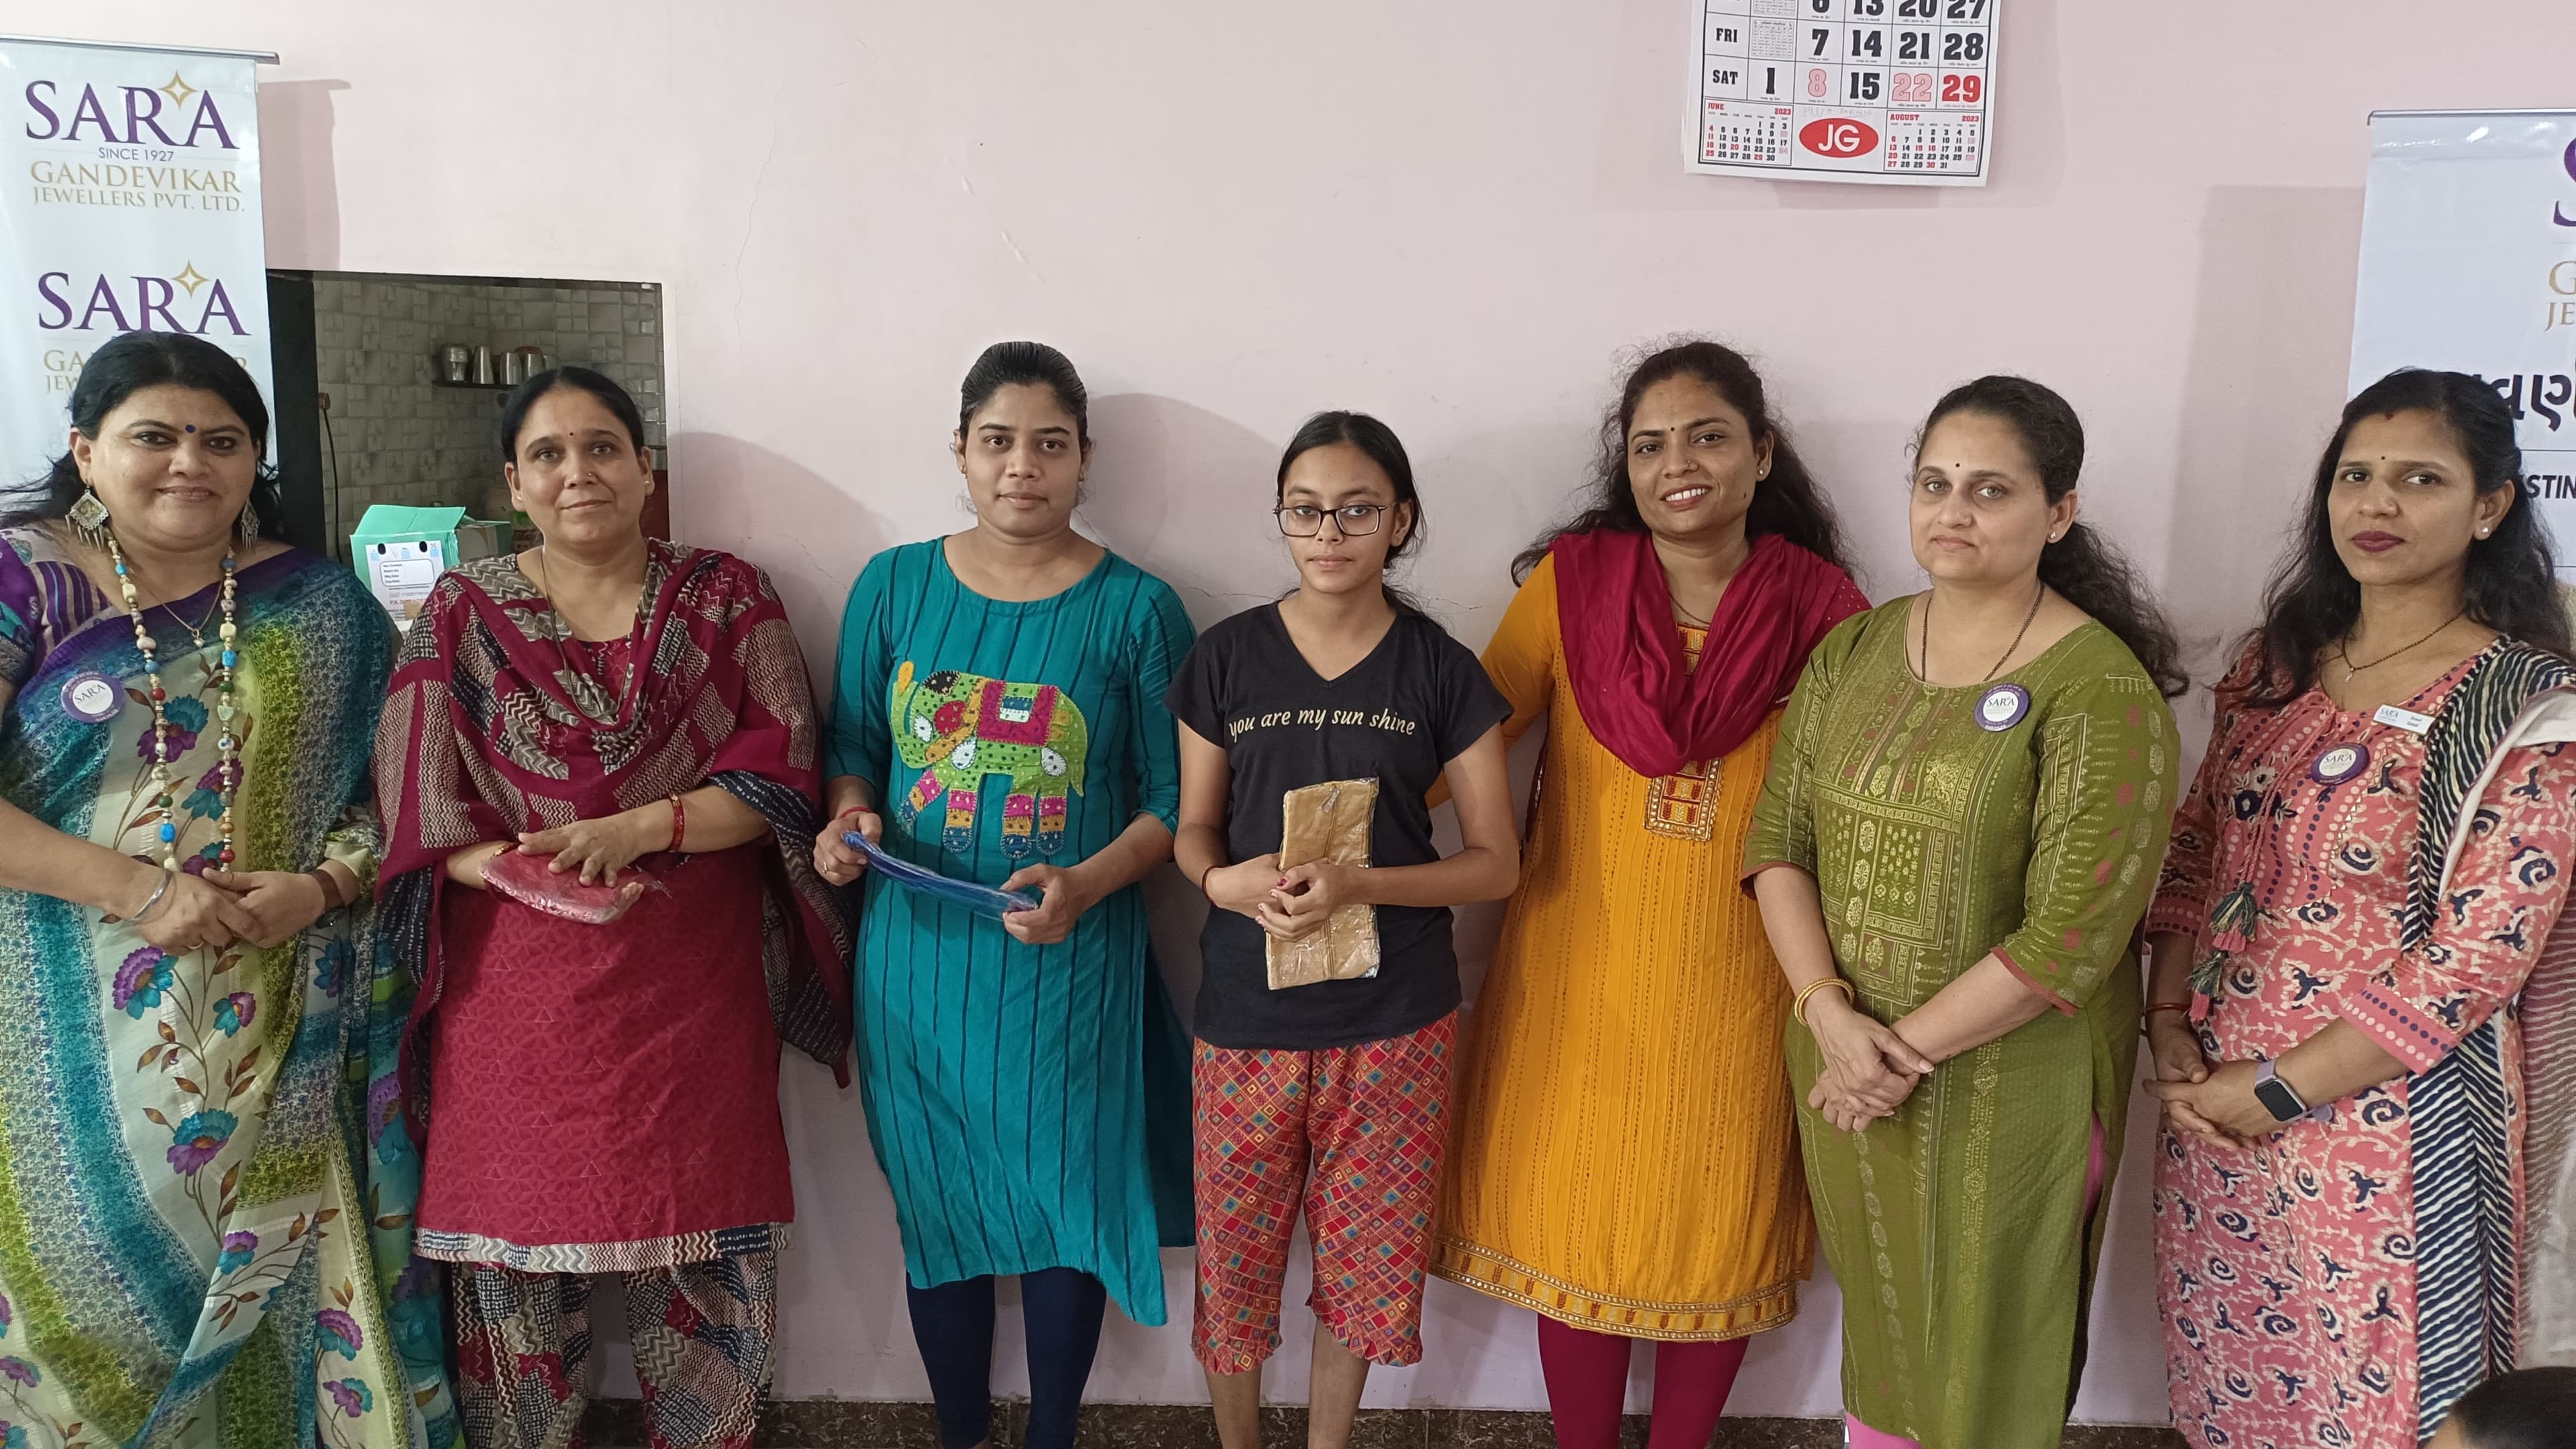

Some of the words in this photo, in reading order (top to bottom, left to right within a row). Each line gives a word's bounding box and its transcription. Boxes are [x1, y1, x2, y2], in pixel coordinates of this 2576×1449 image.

[1898, 0, 1937, 18] 20
[1947, 0, 1986, 19] 27
[1716, 28, 1737, 43] FRI
[1812, 28, 1829, 56] 7
[1851, 30, 1882, 57] 14
[1899, 32, 1930, 60] 21
[1943, 33, 1984, 60] 28
[1713, 70, 1738, 85] SAT
[1766, 67, 1775, 95] 1
[1808, 68, 1826, 97] 8
[1849, 72, 1880, 100] 15
[1892, 73, 1932, 101] 22
[1942, 74, 1981, 103] 29
[26, 80, 240, 149] SARA
[1818, 123, 1860, 152] JG
[98, 148, 139, 160] SINCE
[144, 149, 174, 162] 1927
[30, 160, 241, 193] GANDEVIKAR
[33, 186, 146, 207] JEWELLERS
[154, 193, 194, 209] PVT.
[203, 196, 245, 212] LTD.
[38, 272, 252, 335] SARA
[74, 684, 106, 704] SARA
[1987, 698, 2015, 706] SARA
[1229, 716, 1255, 743] you
[1261, 710, 1291, 727] are
[1297, 708, 1326, 731] my
[1332, 710, 1364, 725] sun
[1369, 708, 1415, 735] shine
[2324, 753, 2353, 763] SARA
